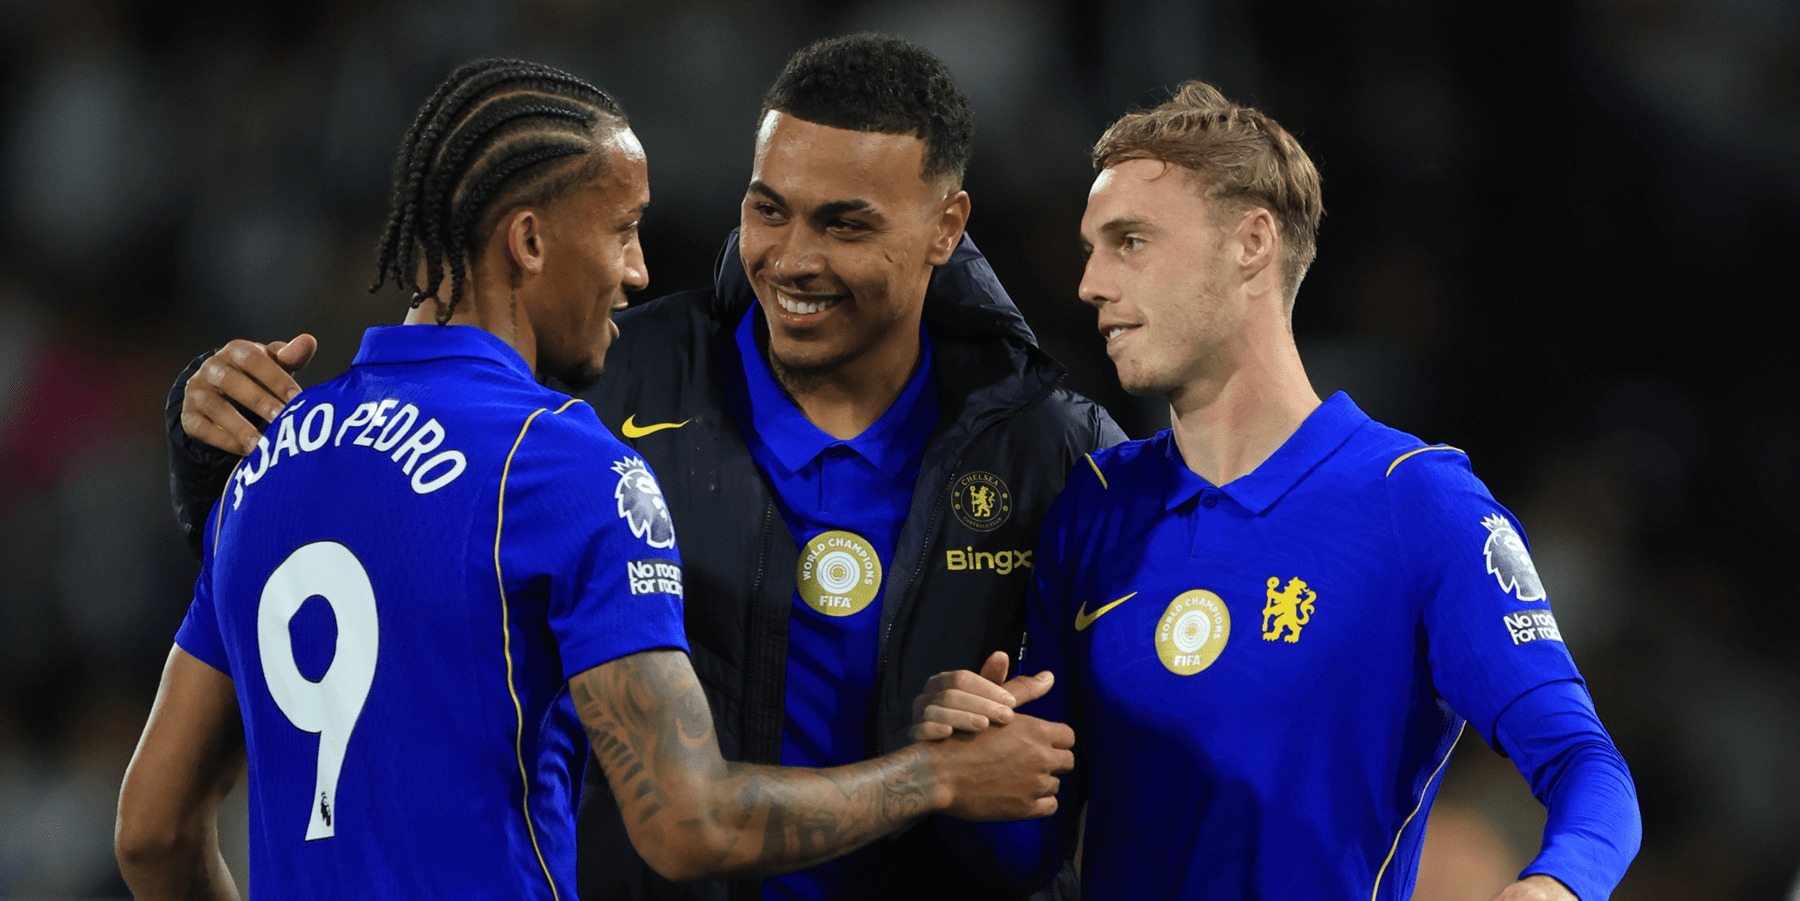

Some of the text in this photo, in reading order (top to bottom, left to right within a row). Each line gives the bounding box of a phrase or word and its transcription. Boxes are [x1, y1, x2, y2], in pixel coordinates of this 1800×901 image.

[334, 398, 467, 495] PEDRO
[961, 473, 999, 486] CHELSEA
[627, 560, 655, 579] No
[803, 538, 874, 586] WORLD CHAMPIONS
[819, 595, 852, 609] FIFA
[1161, 597, 1223, 642] WORLD CHAMPIONS
[1503, 613, 1557, 632] No roo
[1174, 654, 1202, 667] FIFA
[257, 540, 379, 842] 9
